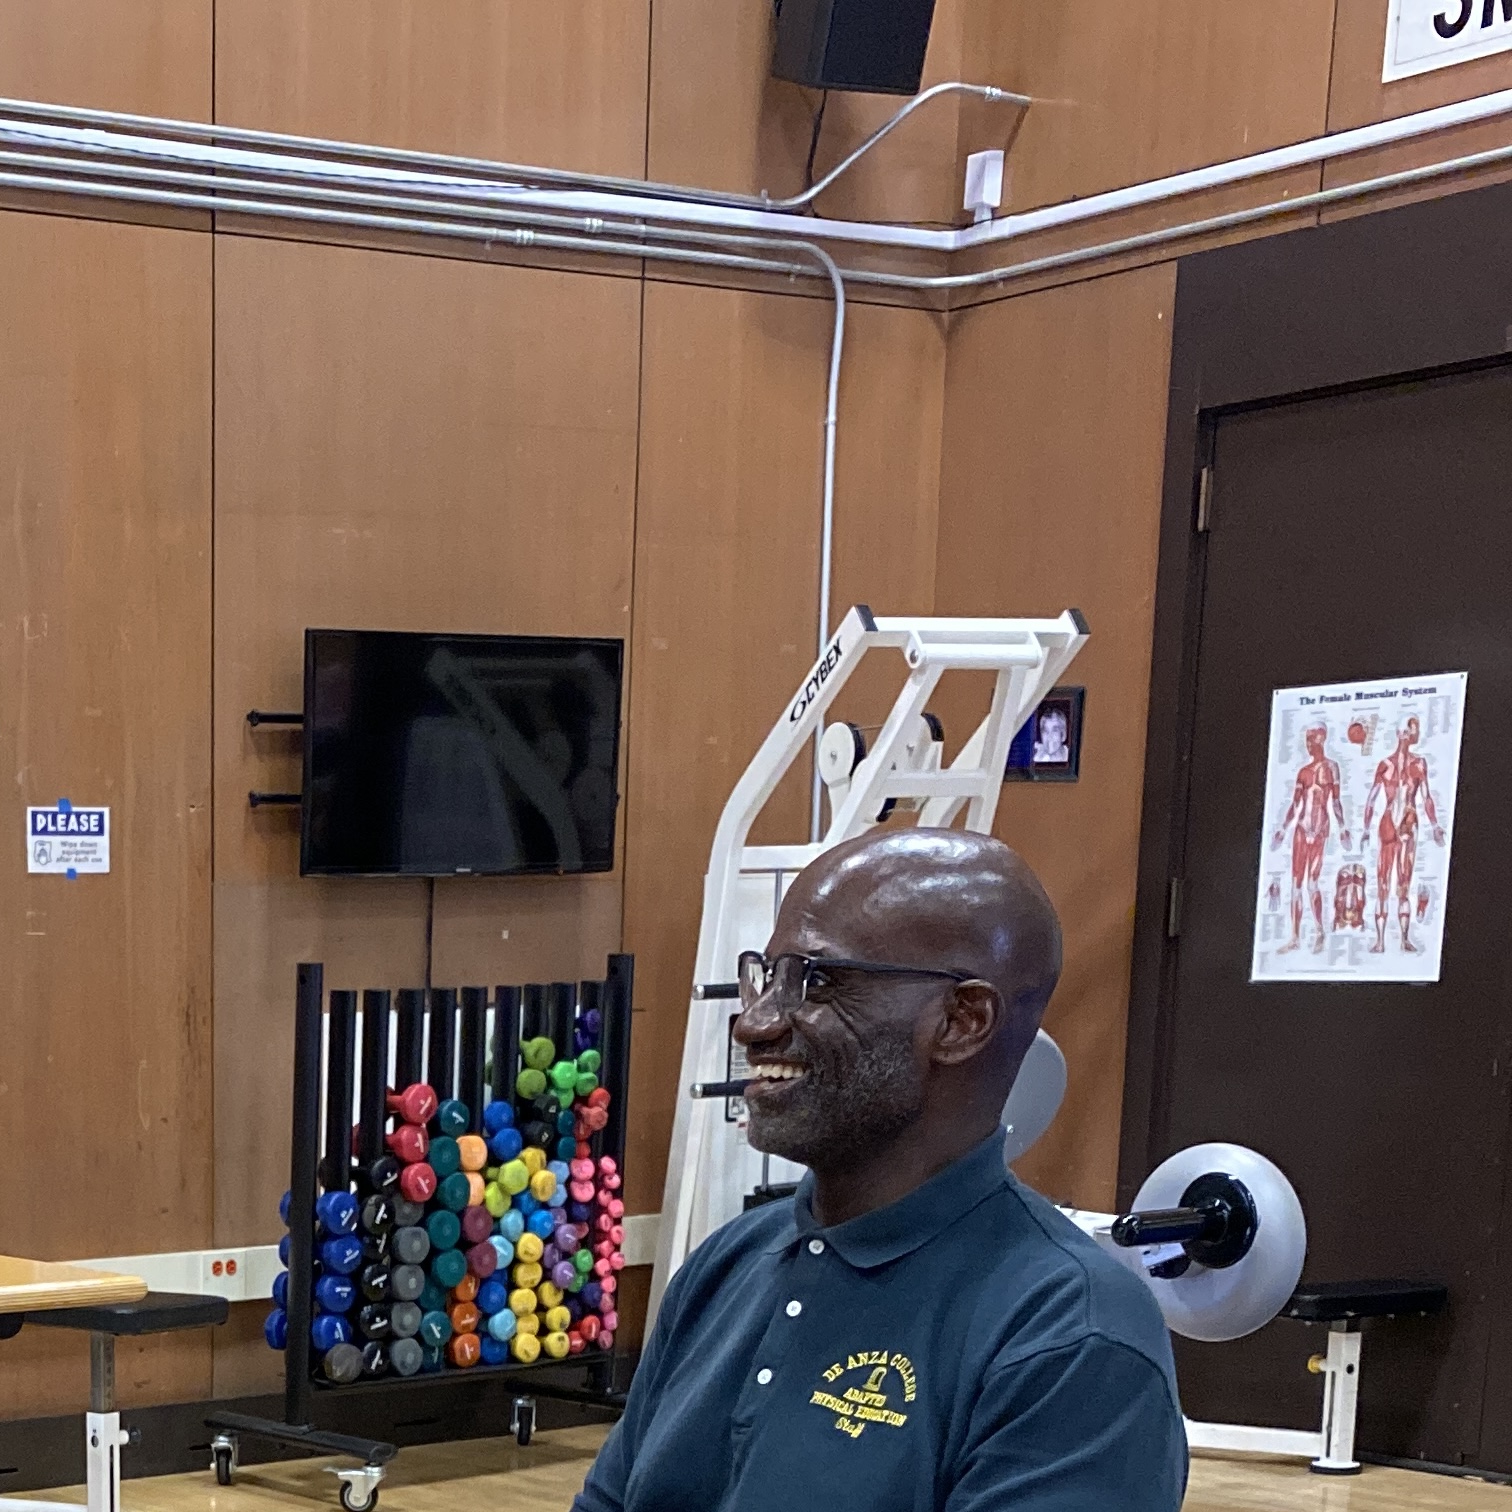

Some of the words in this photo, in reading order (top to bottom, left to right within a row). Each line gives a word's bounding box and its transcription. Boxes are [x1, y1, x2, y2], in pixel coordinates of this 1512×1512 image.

[805, 635, 843, 705] CYBEX
[1299, 696, 1316, 706] The
[1319, 693, 1352, 704] Female
[1355, 689, 1399, 701] Muscular
[1402, 686, 1437, 698] System
[36, 813, 100, 832] PLEASE
[822, 1363, 845, 1382] DE
[846, 1350, 889, 1370] ANZA
[890, 1353, 917, 1402] COLLEGE
[809, 1390, 854, 1416] PHYSICAL
[853, 1405, 908, 1428] EDUCATION
[835, 1416, 866, 1438] Staff
